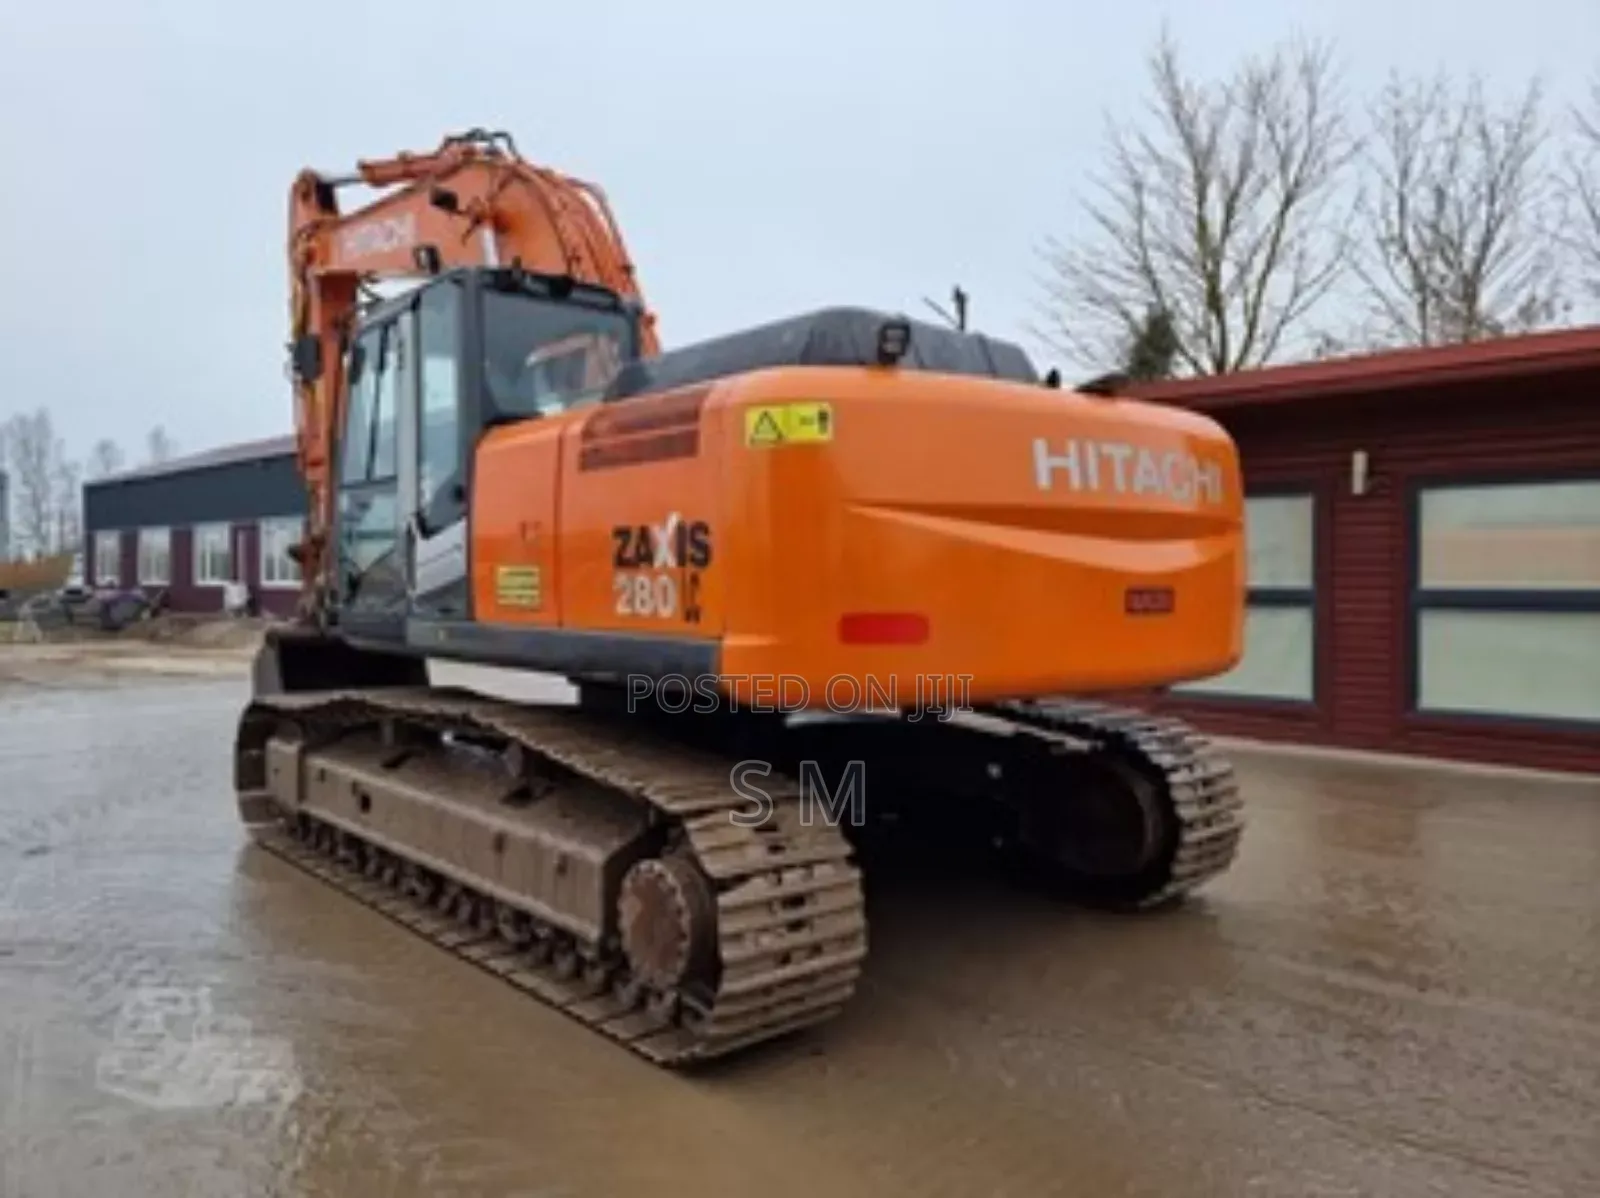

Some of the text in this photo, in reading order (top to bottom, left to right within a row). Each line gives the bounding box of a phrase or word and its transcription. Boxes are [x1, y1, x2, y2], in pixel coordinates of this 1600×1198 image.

[1033, 438, 1222, 504] HITACHI
[612, 512, 711, 568] ZAXIS
[613, 573, 677, 617] 280
